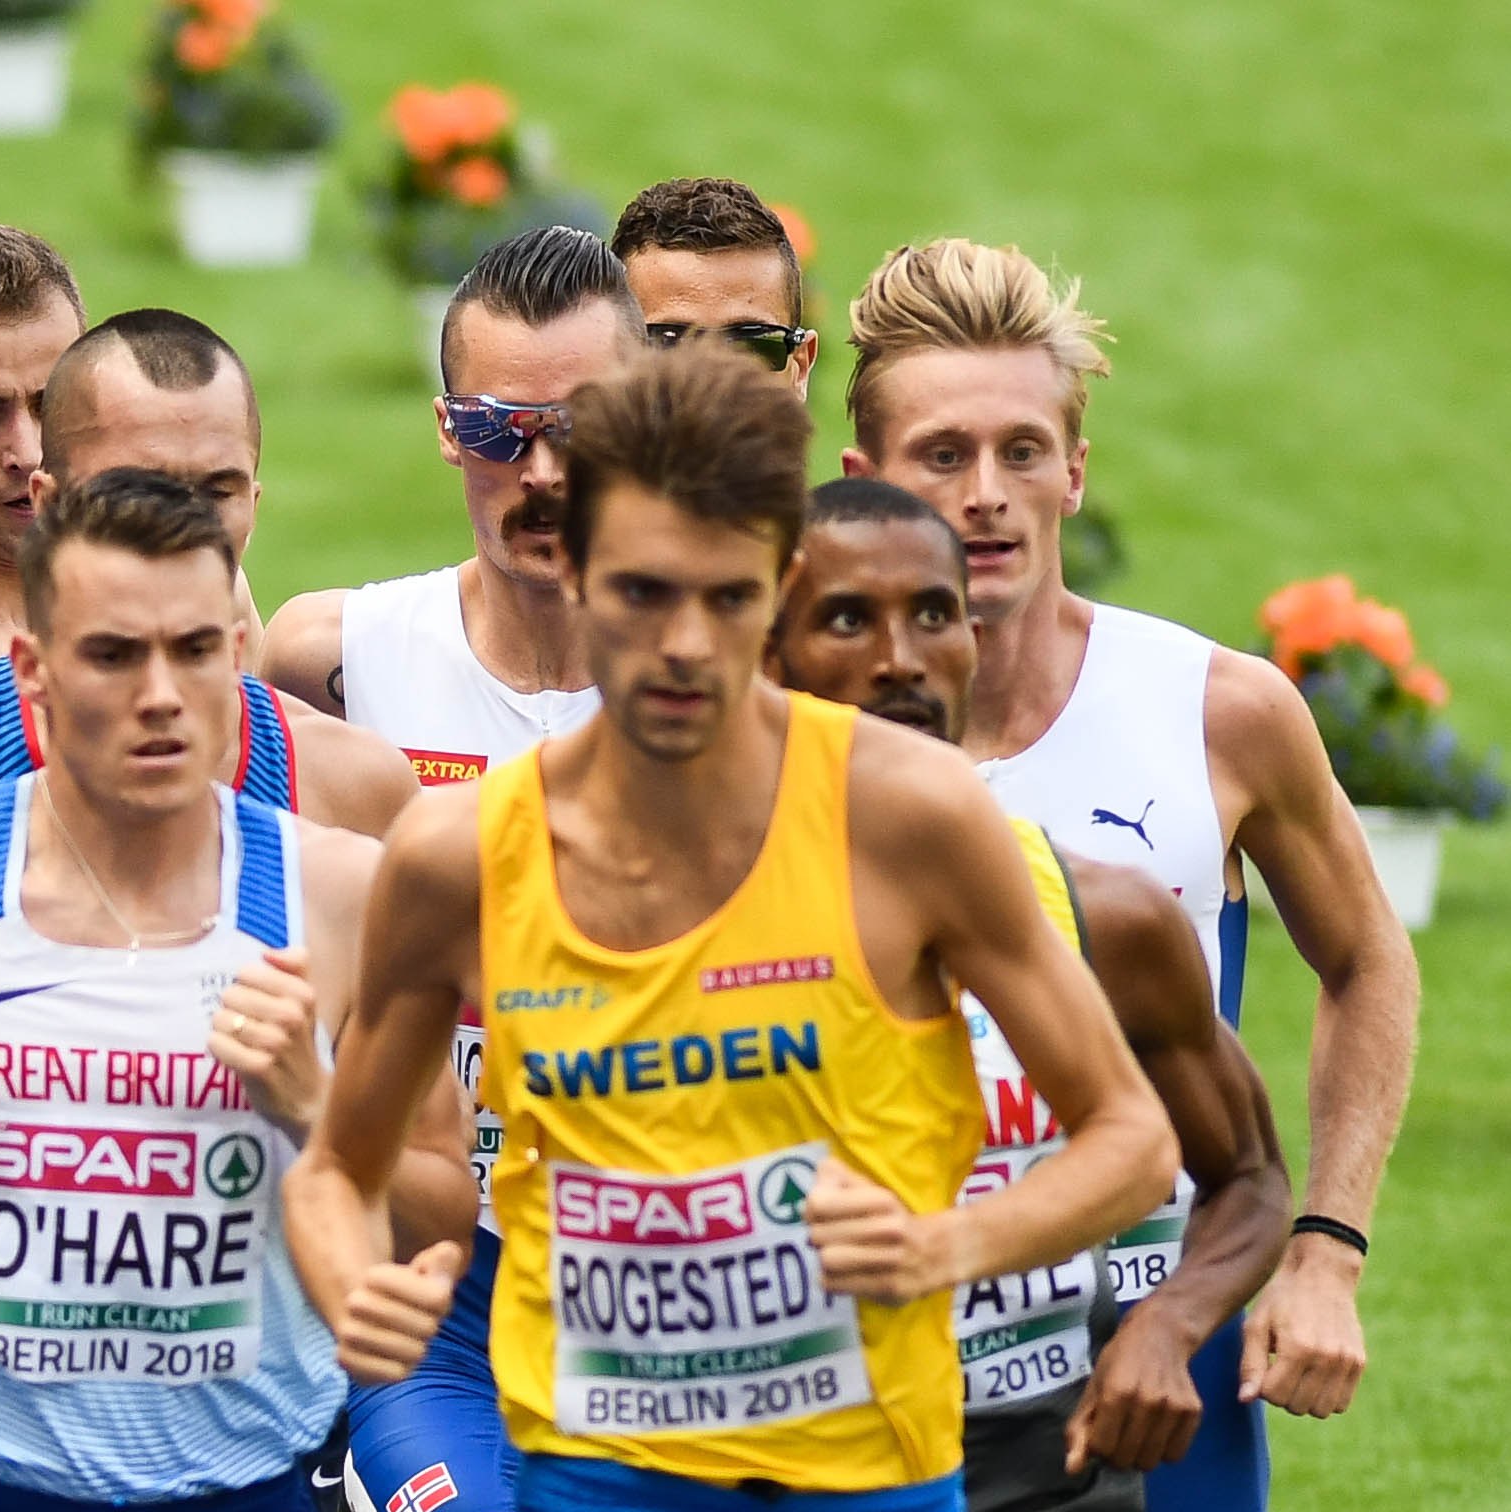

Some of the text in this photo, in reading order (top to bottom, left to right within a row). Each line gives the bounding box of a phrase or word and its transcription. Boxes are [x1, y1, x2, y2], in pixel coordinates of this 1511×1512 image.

[411, 759, 480, 779] EXTRA
[522, 1021, 821, 1099] SWEDEN
[557, 1178, 747, 1239] SPAR
[560, 1243, 833, 1337] ROGESTED
[144, 1341, 235, 1376] 2018
[962, 1328, 1019, 1360] LEAN
[985, 1343, 1070, 1399] 2018
[587, 1367, 839, 1425] BERLIN 2018
